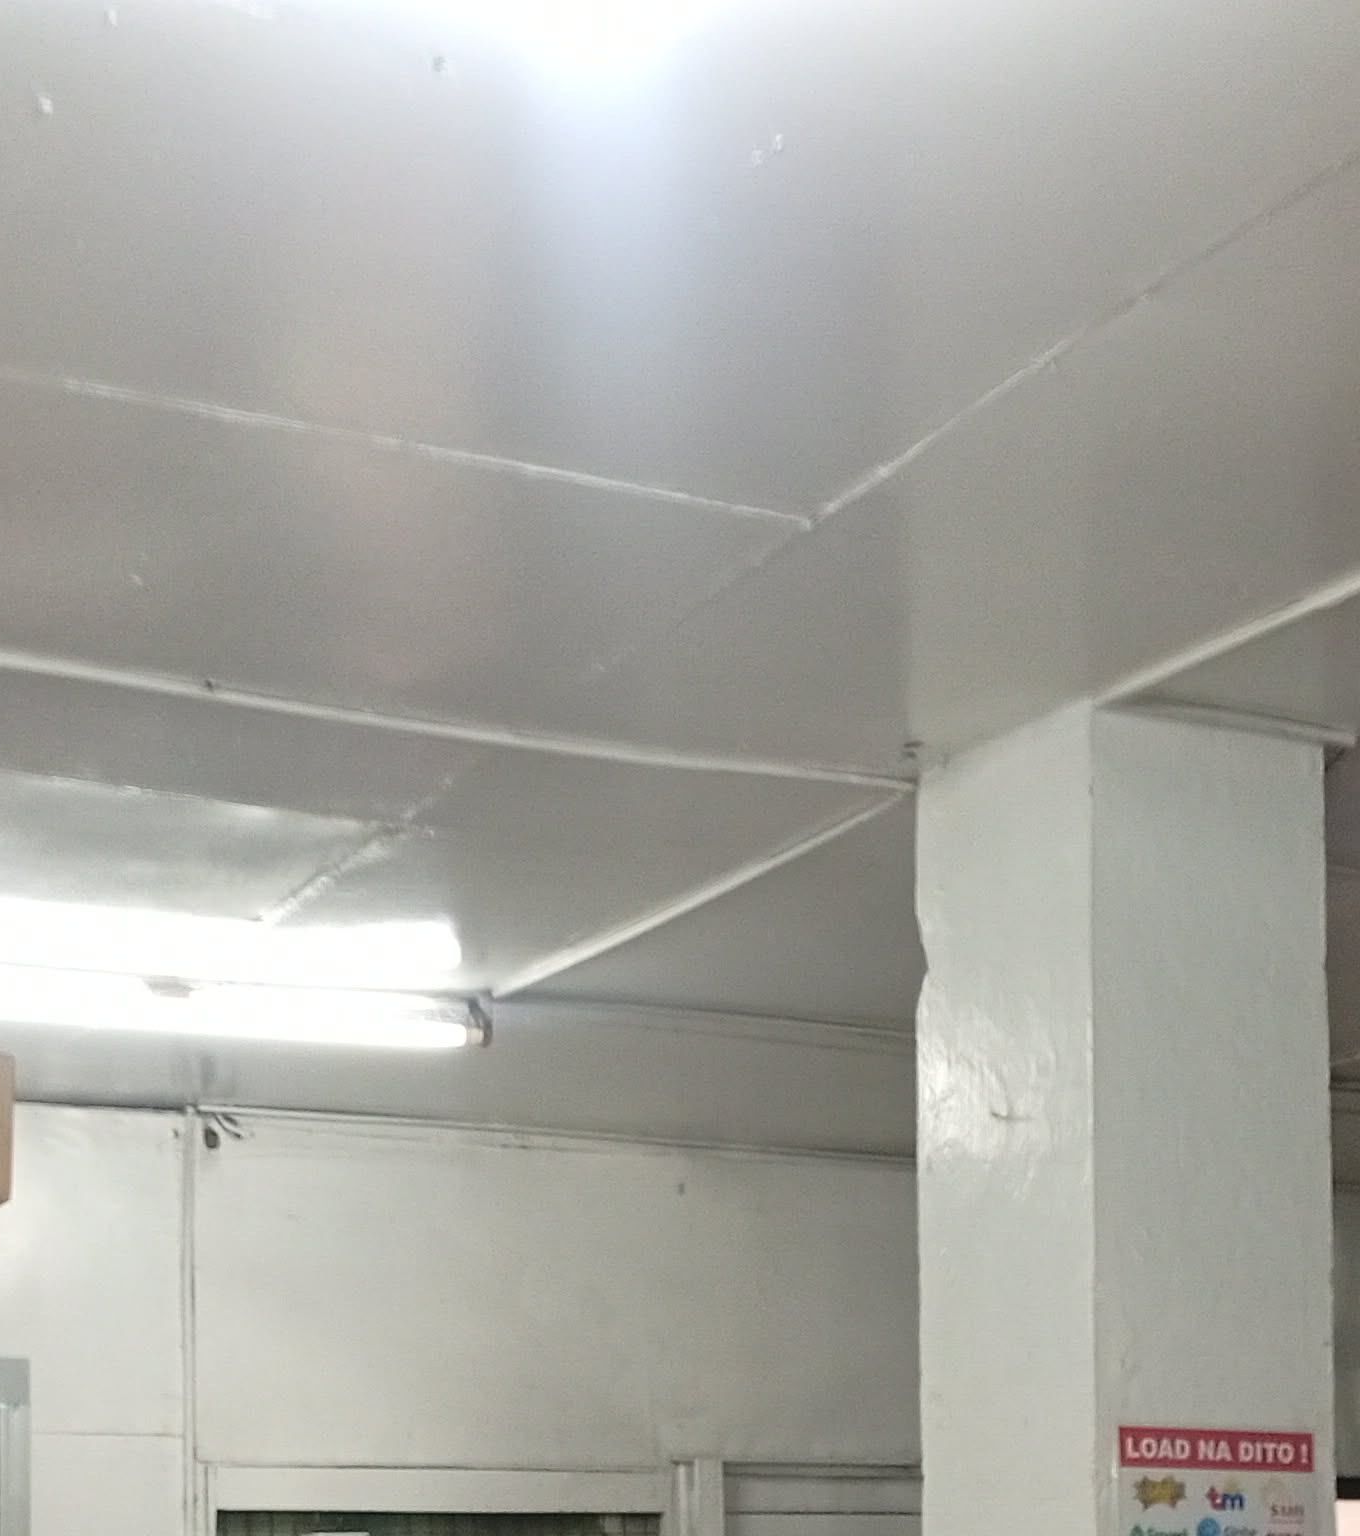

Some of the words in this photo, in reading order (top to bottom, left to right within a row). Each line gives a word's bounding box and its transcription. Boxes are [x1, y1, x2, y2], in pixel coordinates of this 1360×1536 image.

[1125, 1436, 1190, 1460] LOAD
[1197, 1438, 1232, 1462] NA
[1239, 1441, 1295, 1464] DITO
